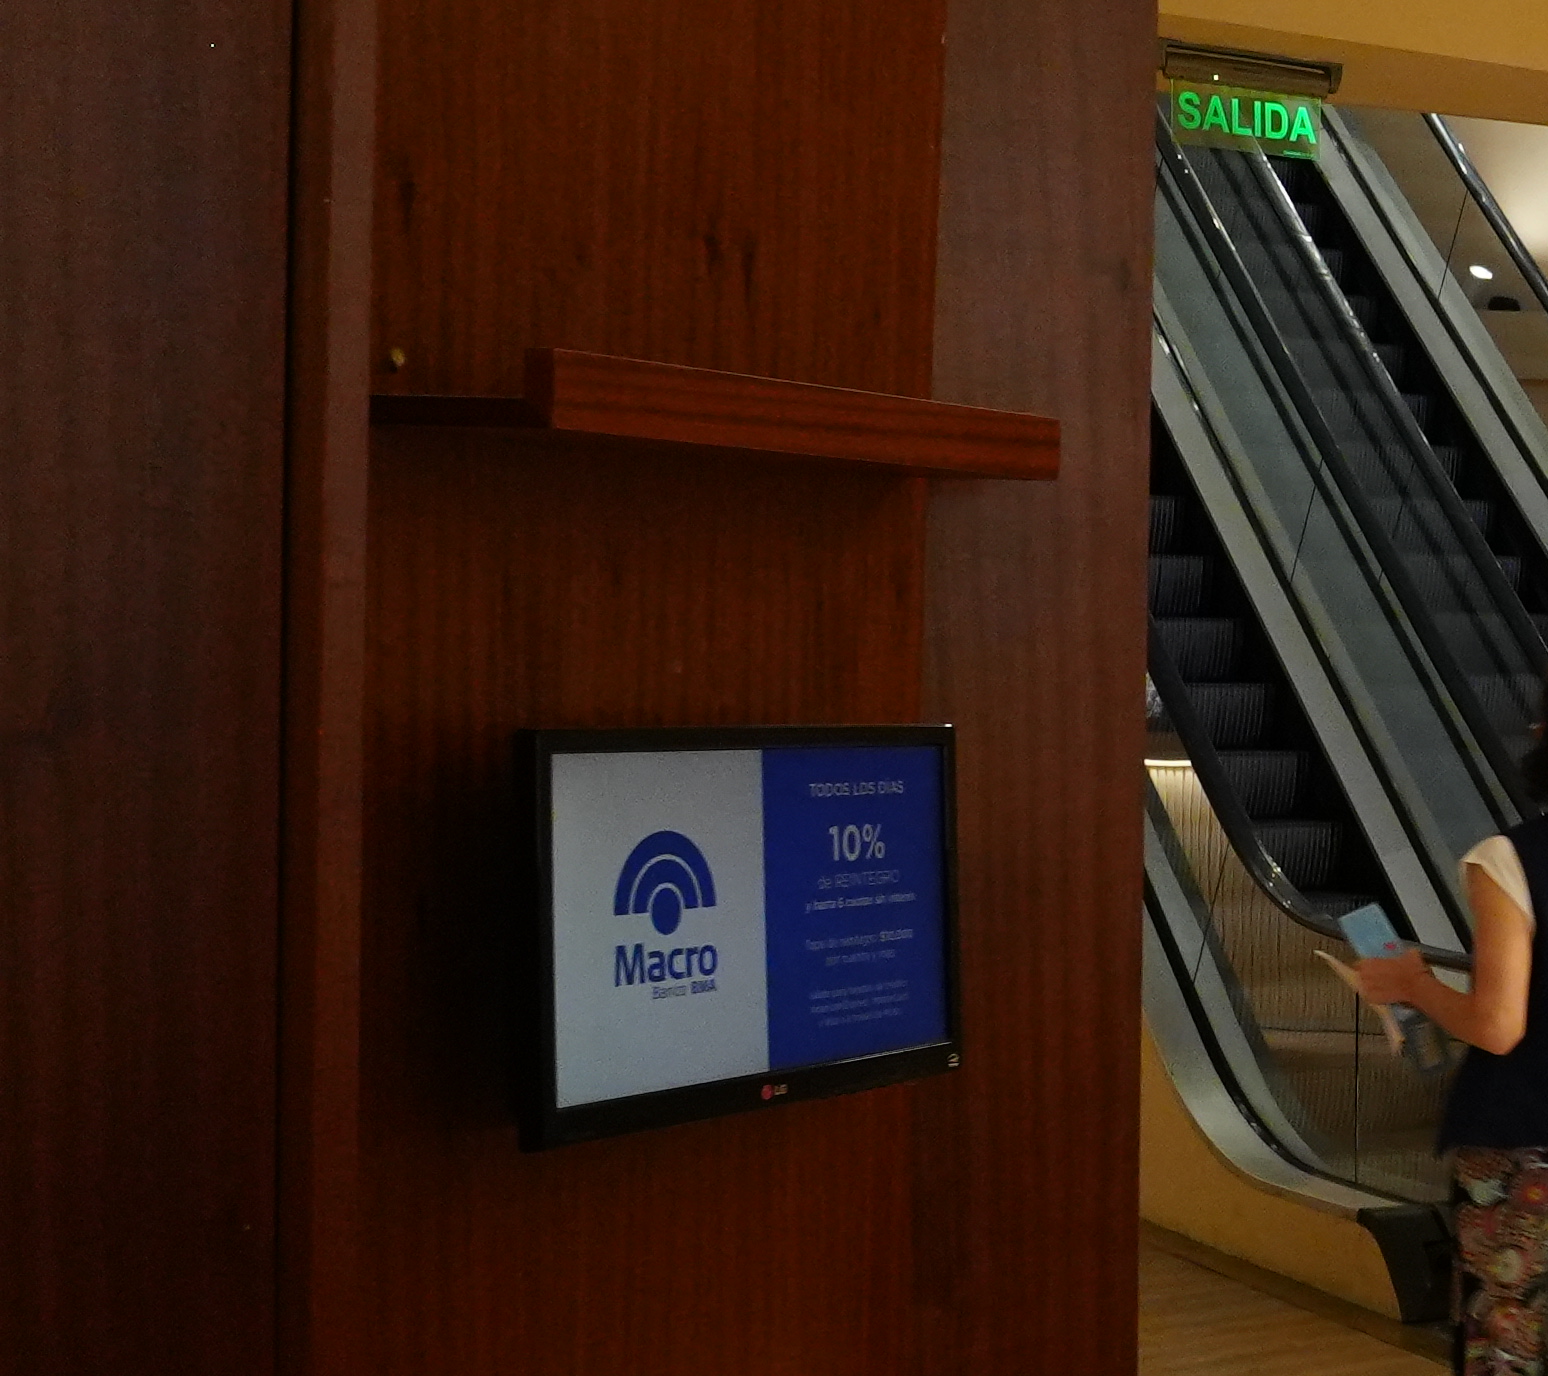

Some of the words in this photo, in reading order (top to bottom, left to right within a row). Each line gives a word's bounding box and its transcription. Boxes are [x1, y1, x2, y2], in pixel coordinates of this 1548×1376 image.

[1178, 91, 1317, 144] SALIDA
[809, 782, 850, 796] TODOS
[853, 781, 876, 795] LOS
[829, 824, 886, 861] 10%
[818, 876, 832, 889] de
[615, 943, 718, 987] Macro
[653, 985, 686, 999] Banco
